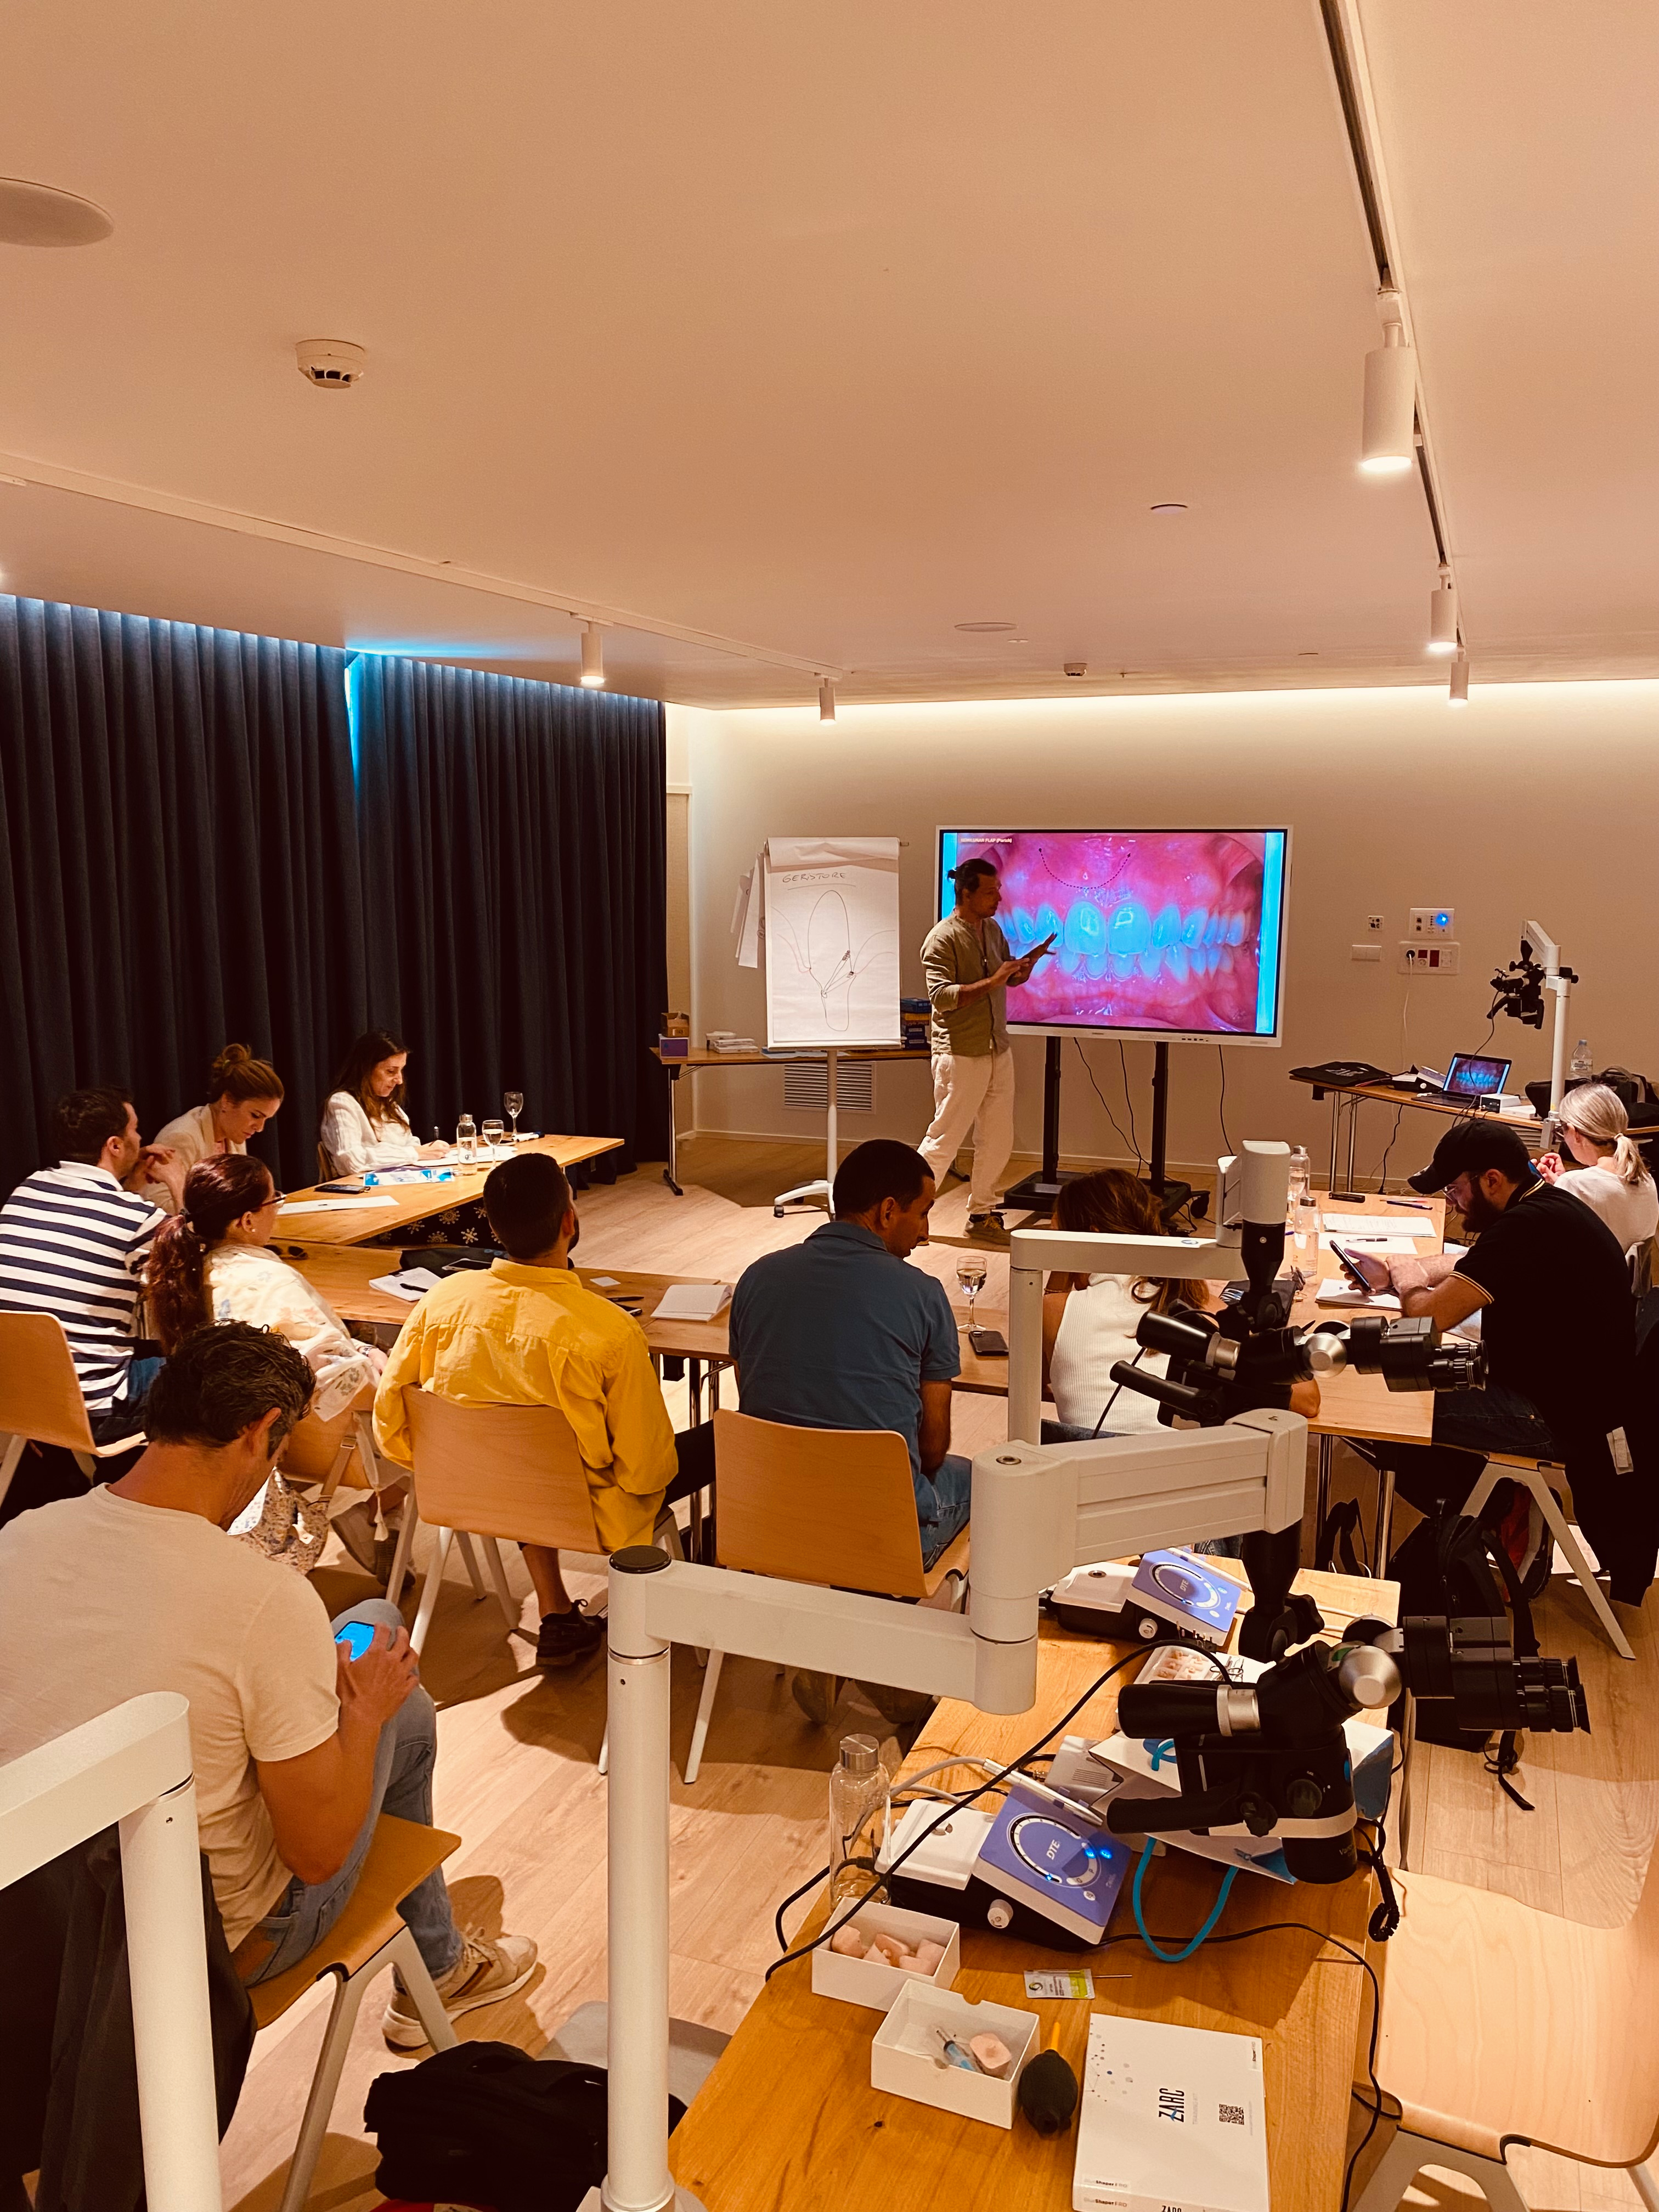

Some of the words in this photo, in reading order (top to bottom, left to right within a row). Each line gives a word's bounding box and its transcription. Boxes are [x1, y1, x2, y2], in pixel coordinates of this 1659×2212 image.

[1180, 1579, 1189, 1592] DTE
[1046, 1839, 1060, 1860] DTE
[1158, 2088, 1184, 2123] ZARC
